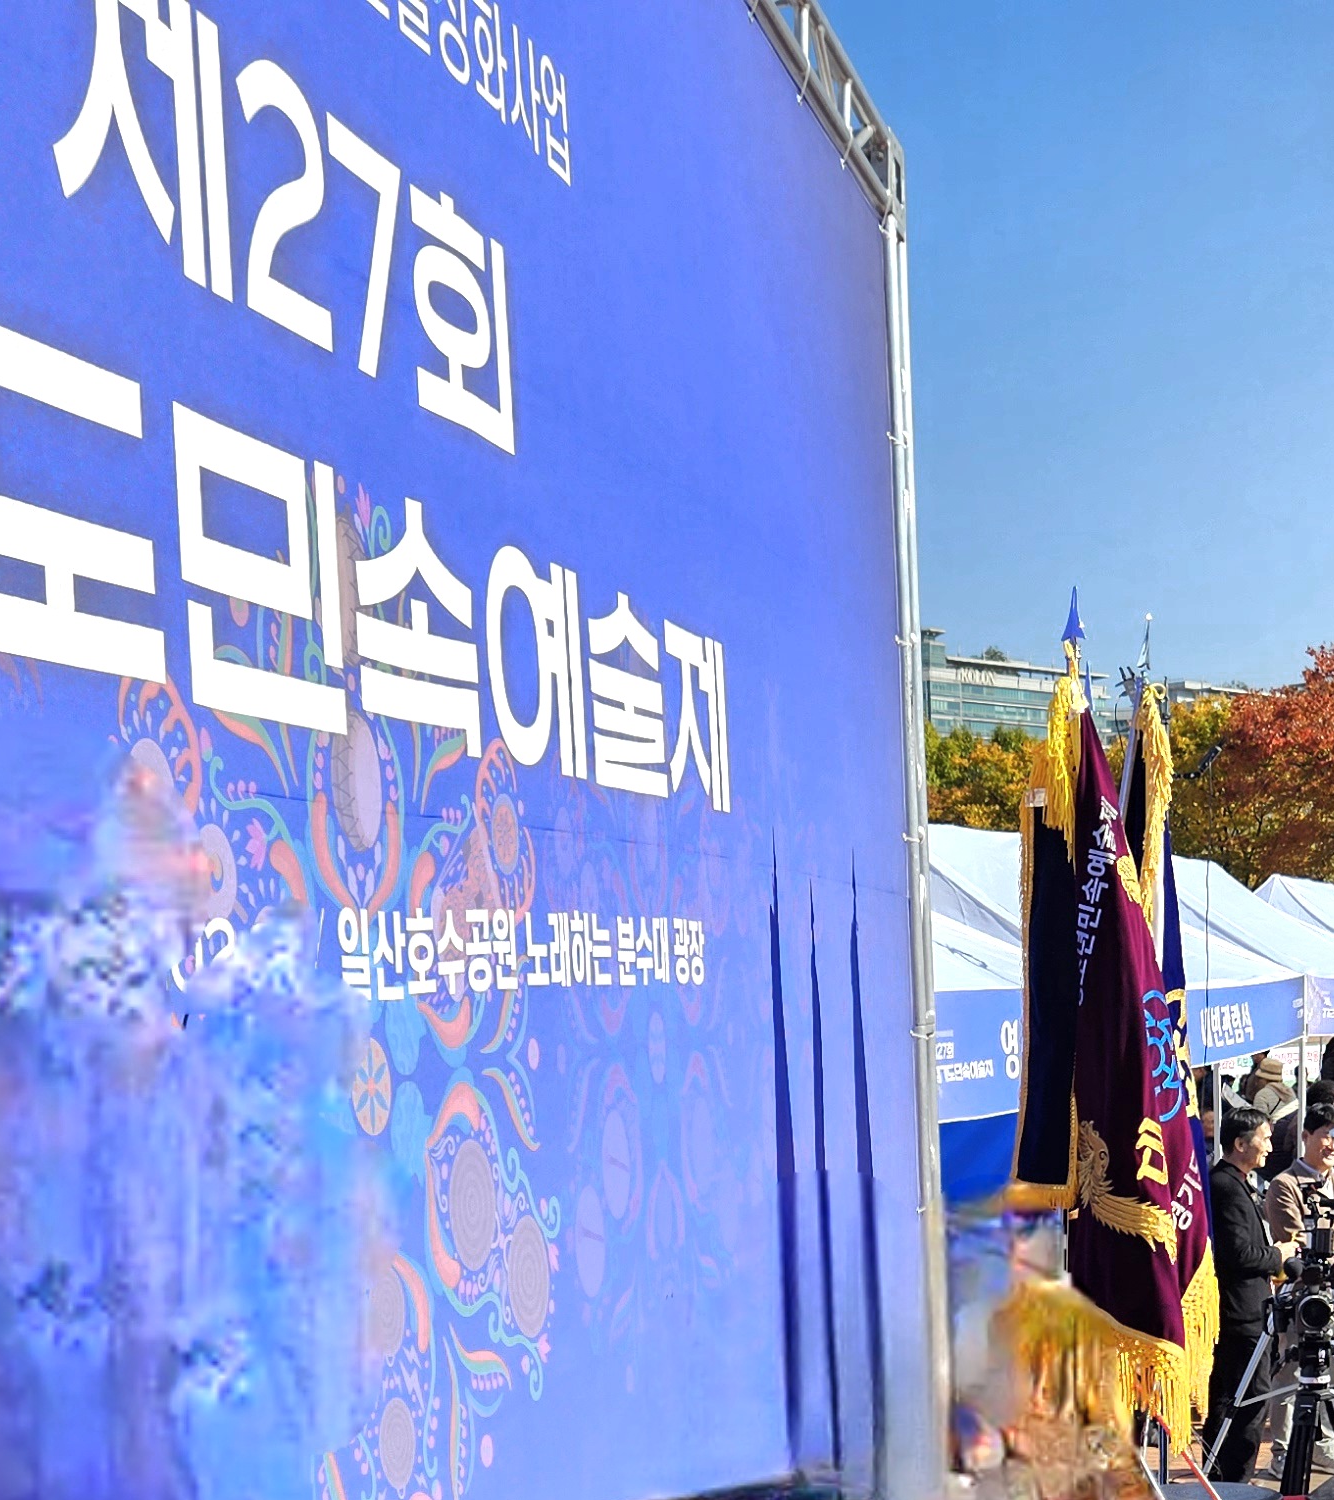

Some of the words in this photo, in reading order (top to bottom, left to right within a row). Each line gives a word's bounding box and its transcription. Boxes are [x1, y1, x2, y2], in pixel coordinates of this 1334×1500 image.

[398, 0, 571, 187] 성화사업
[53, 0, 515, 456] 제27회
[337, 908, 519, 1002] 일산호수공원
[525, 910, 612, 988] 노래하는
[618, 913, 670, 986] 분수대
[674, 916, 705, 986] 광장
